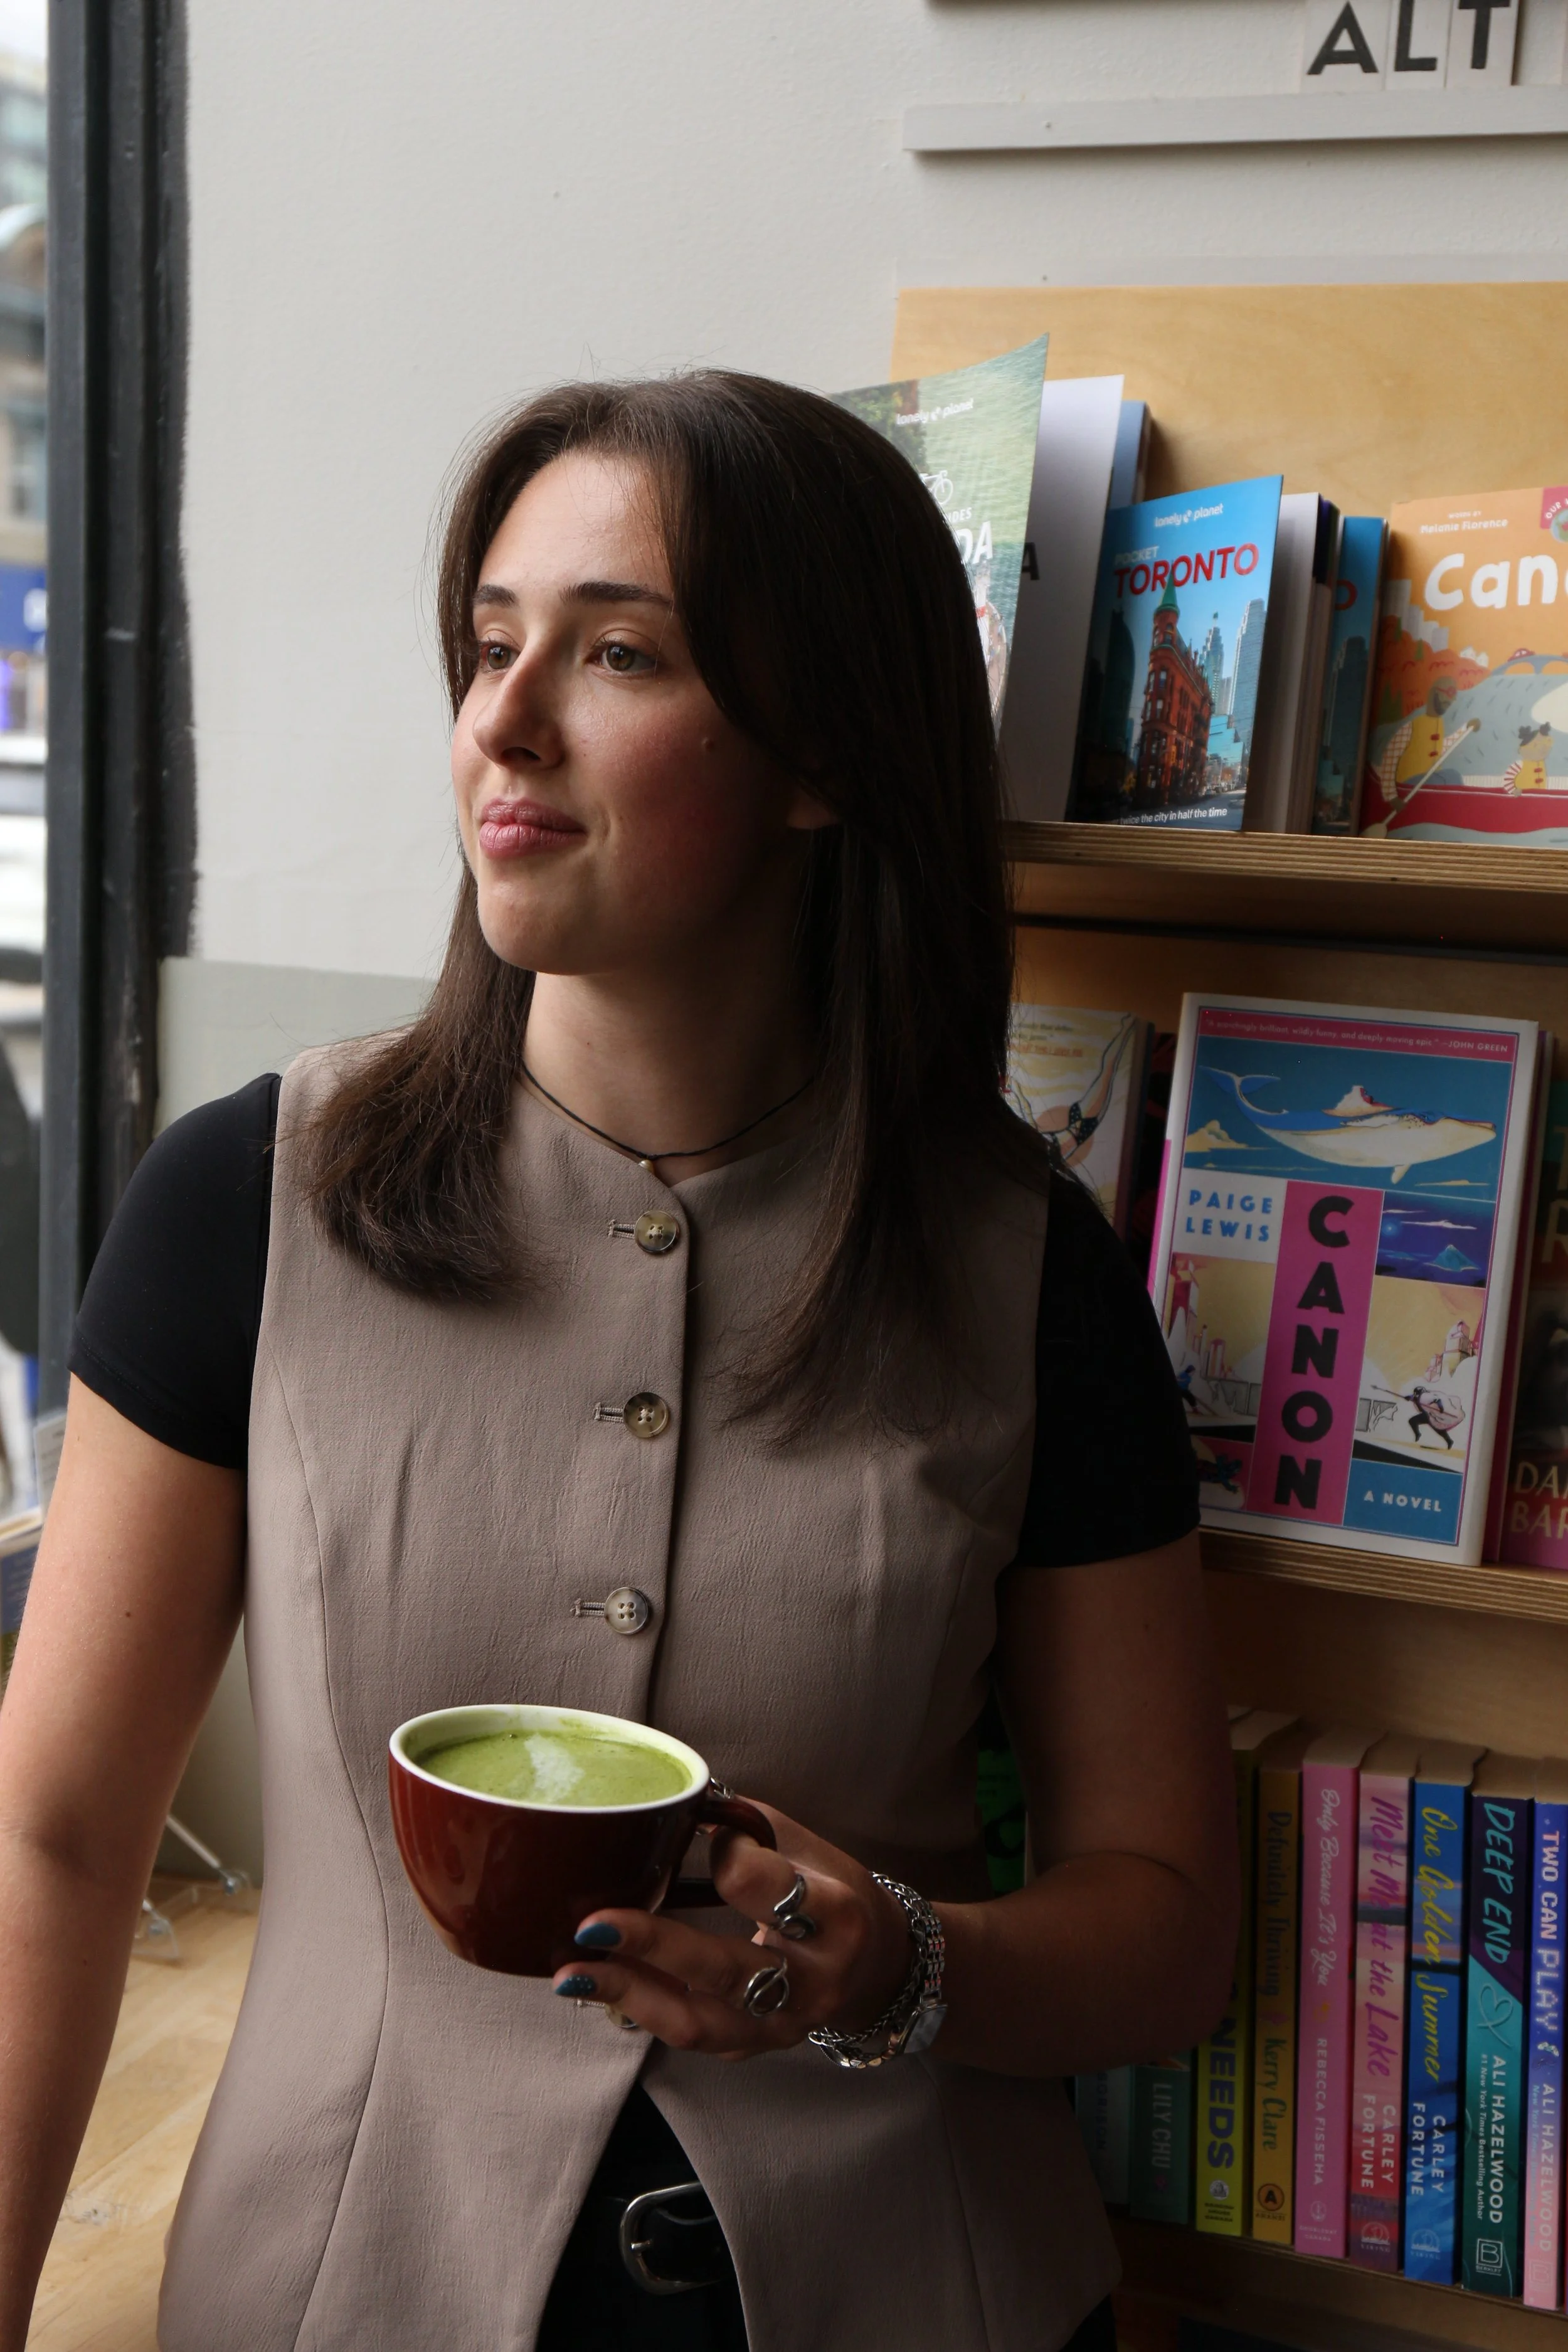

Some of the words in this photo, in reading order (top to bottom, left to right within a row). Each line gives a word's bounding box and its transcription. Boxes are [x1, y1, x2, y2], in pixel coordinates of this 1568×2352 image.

[1307, 0, 1511, 75] ALT
[896, 410, 930, 425] lonely
[943, 398, 974, 418] planet
[948, 507, 972, 524] IDES
[1155, 512, 1182, 527] lonely
[1193, 503, 1224, 521] planet
[1420, 522, 1459, 534] Melanie
[1461, 519, 1508, 531] Florence
[1545, 501, 1562, 519] OUR
[1113, 542, 1259, 599] TORONTO
[1115, 546, 1159, 564] POCKET
[1424, 552, 1568, 611] Can
[1141, 814, 1153, 824] the
[1154, 812, 1169, 823] city
[1170, 811, 1177, 820] in
[1178, 809, 1193, 820] half
[1194, 808, 1207, 818] the
[1208, 807, 1227, 817] time
[1292, 1025, 1314, 1037] wildly
[1342, 1031, 1356, 1039] and
[1358, 1032, 1383, 1042] deeply
[1386, 1036, 1414, 1046] moving
[1477, 1042, 1508, 1052] GREEN
[1190, 1190, 1273, 1214] PAIGE
[1185, 1217, 1269, 1242] LEWIS
[1274, 1195, 1354, 1510] CANON
[1364, 1490, 1374, 1502] A
[1383, 1493, 1442, 1512] NOVEL
[1514, 1461, 1568, 1500] DA
[1316, 1789, 1340, 1831] Only
[1370, 1796, 1404, 1868] Meet
[1421, 1806, 1458, 1858] One
[1483, 1801, 1517, 1895] DEEP
[1259, 1811, 1292, 1907] Definitely
[1320, 1836, 1340, 1906] Because
[1540, 1831, 1560, 1882] TWO
[1368, 1869, 1401, 1911] Me
[1318, 1908, 1337, 1944] It's
[1417, 1864, 1454, 1970] Golden
[1482, 1896, 1514, 1964] END
[1539, 1891, 1559, 1940] CAN
[1257, 1917, 1290, 1996] Thriving
[1370, 1919, 1393, 1955] at
[1311, 1948, 1337, 1986] You
[1369, 1957, 1394, 1999] the
[1534, 1947, 1561, 2032] PLAY
[1365, 2001, 1400, 2077] Lake
[1416, 1972, 1449, 2084] Summer
[1255, 2038, 1288, 2092] Kerry
[1315, 2037, 1328, 2112] REBECCA
[1480, 2066, 1488, 2088] New
[1493, 2055, 1507, 2087] ALI
[1152, 2082, 1173, 2123] LILY
[1480, 2089, 1488, 2109] York
[1532, 2084, 1540, 2106] New
[1542, 2083, 1556, 2115] ALI
[1261, 2097, 1288, 2151] Clare
[1361, 2093, 1377, 2189] FORTUNE
[1381, 2104, 1396, 2184] CARLEY
[1479, 2111, 1487, 2136] Times
[1152, 2127, 1172, 2169] CHU
[1313, 2117, 1326, 2186] FISSEHA
[1411, 2102, 1426, 2196] FORTUNE
[1431, 2114, 1446, 2193] CARLEY
[1476, 2137, 1486, 2187] Bestselling
[1489, 2094, 1506, 2224] HAZELWOOD
[1476, 2189, 1485, 2220] Author
[1539, 2124, 1555, 2252] HAZELWOOD
[1360, 2243, 1391, 2253] VIKING
[1411, 2250, 1441, 2260] VIKING
[1480, 2243, 1500, 2264] B
[1475, 2265, 1502, 2275] BERKLEY
